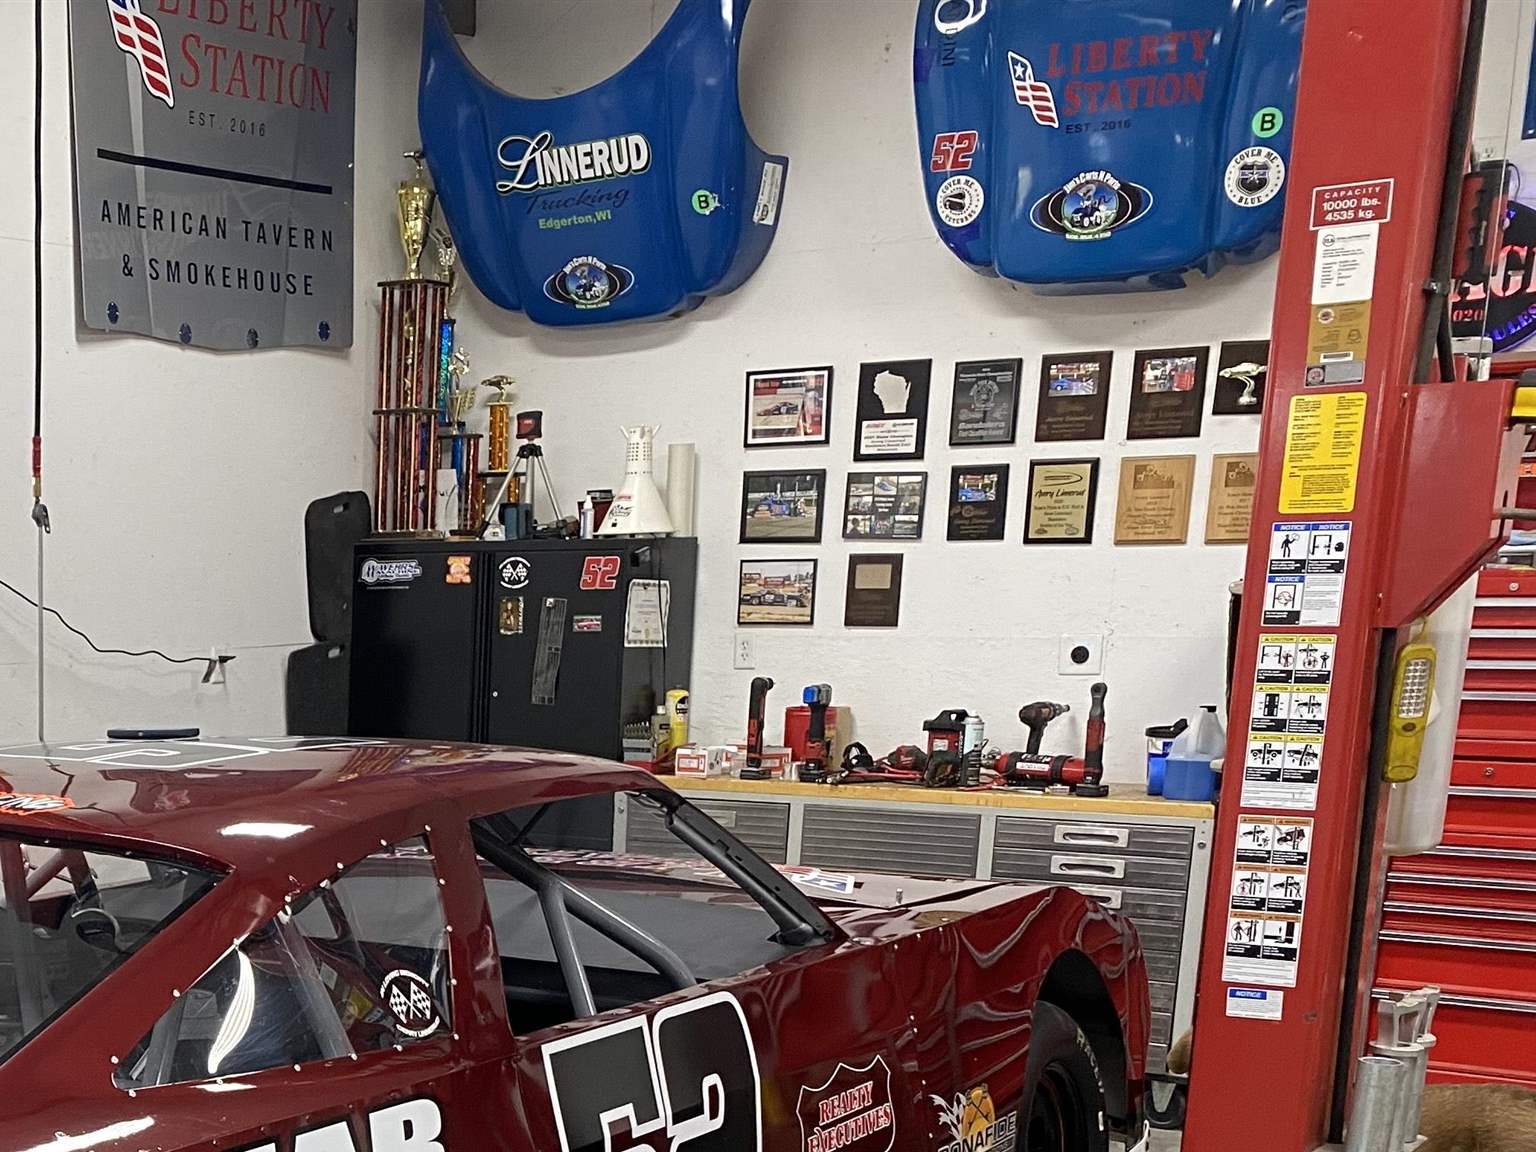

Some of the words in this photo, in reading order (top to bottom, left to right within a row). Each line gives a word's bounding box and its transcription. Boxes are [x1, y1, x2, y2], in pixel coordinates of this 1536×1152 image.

[158, 0, 335, 49] BERTY
[1047, 29, 1213, 77] LIBERTY
[179, 32, 332, 114] STATION
[1064, 71, 1205, 117] STATION
[230, 118, 266, 137] 2016
[1100, 118, 1132, 132] 2016
[1260, 112, 1276, 132] B
[496, 131, 651, 194] LINNERUD
[930, 131, 979, 172] 52
[1234, 148, 1263, 165] COVER
[524, 187, 630, 216] Trucking
[698, 195, 710, 209] B
[1238, 194, 1263, 205] BLUE
[1322, 198, 1358, 211] 10000
[1361, 197, 1382, 207] lbs.
[1324, 186, 1381, 199] CAPACITY
[101, 199, 227, 240] AMERICAN
[242, 220, 333, 251] TAVERN
[1325, 209, 1355, 221] 4535
[1358, 208, 1376, 219] kg.
[122, 253, 134, 278] &
[148, 258, 314, 296] SMOKEHOUSE
[1452, 309, 1484, 322] 020
[580, 556, 620, 589] 52
[819, 1081, 873, 1125] REALTY
